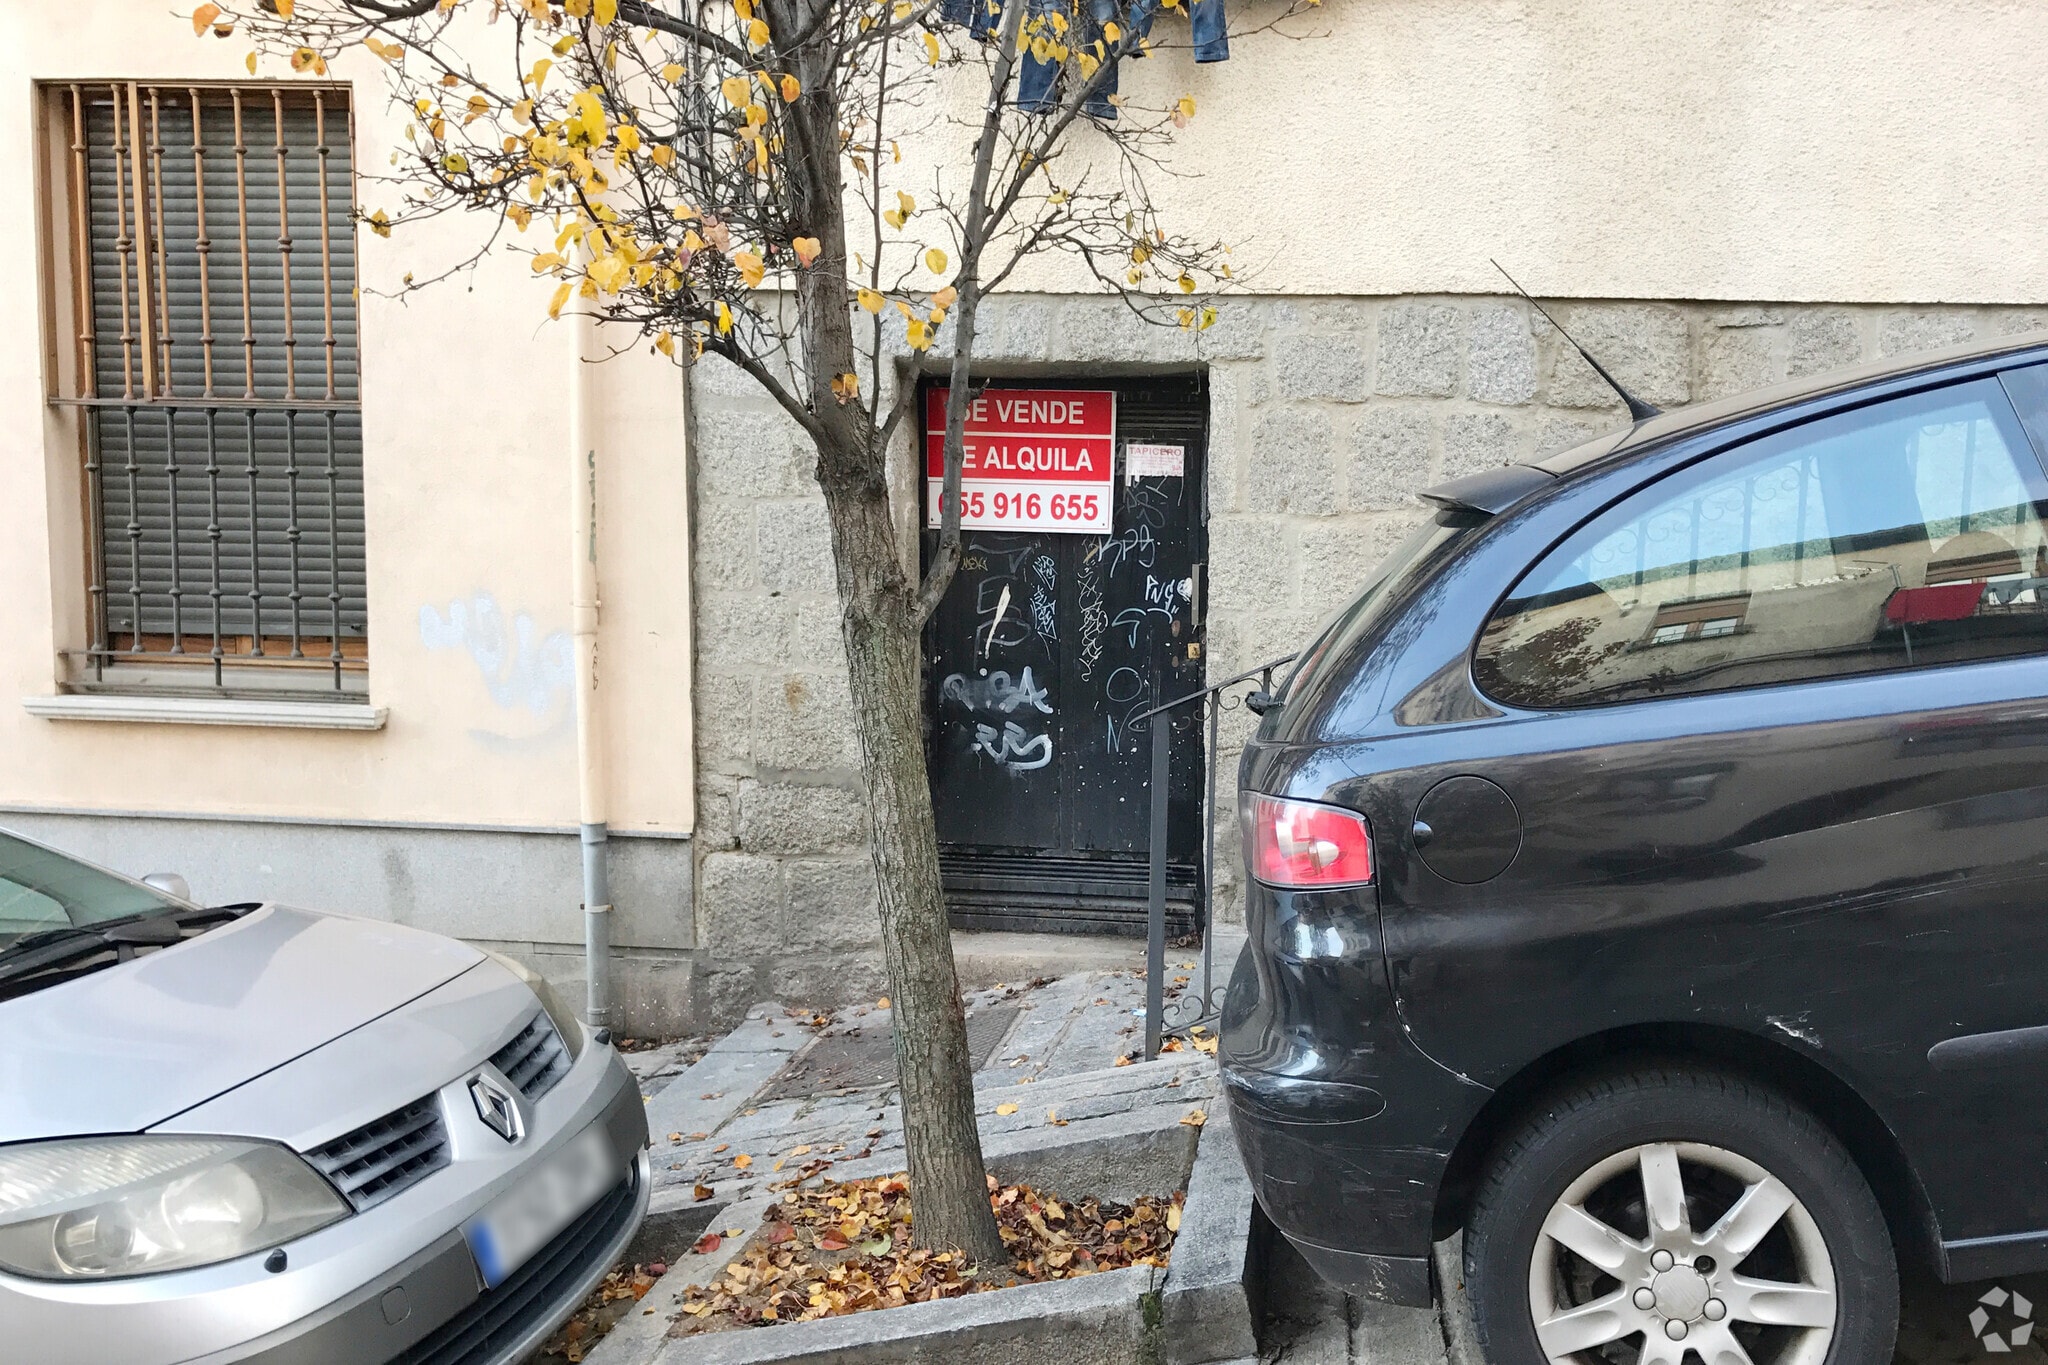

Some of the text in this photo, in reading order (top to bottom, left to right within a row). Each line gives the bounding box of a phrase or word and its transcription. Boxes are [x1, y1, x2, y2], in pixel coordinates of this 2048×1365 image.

[995, 399, 1085, 425] VENDE
[983, 446, 1094, 472] ALQUILA
[1129, 446, 1182, 456] TAPICERO
[993, 492, 1042, 520] 916
[1050, 493, 1099, 521] 655
